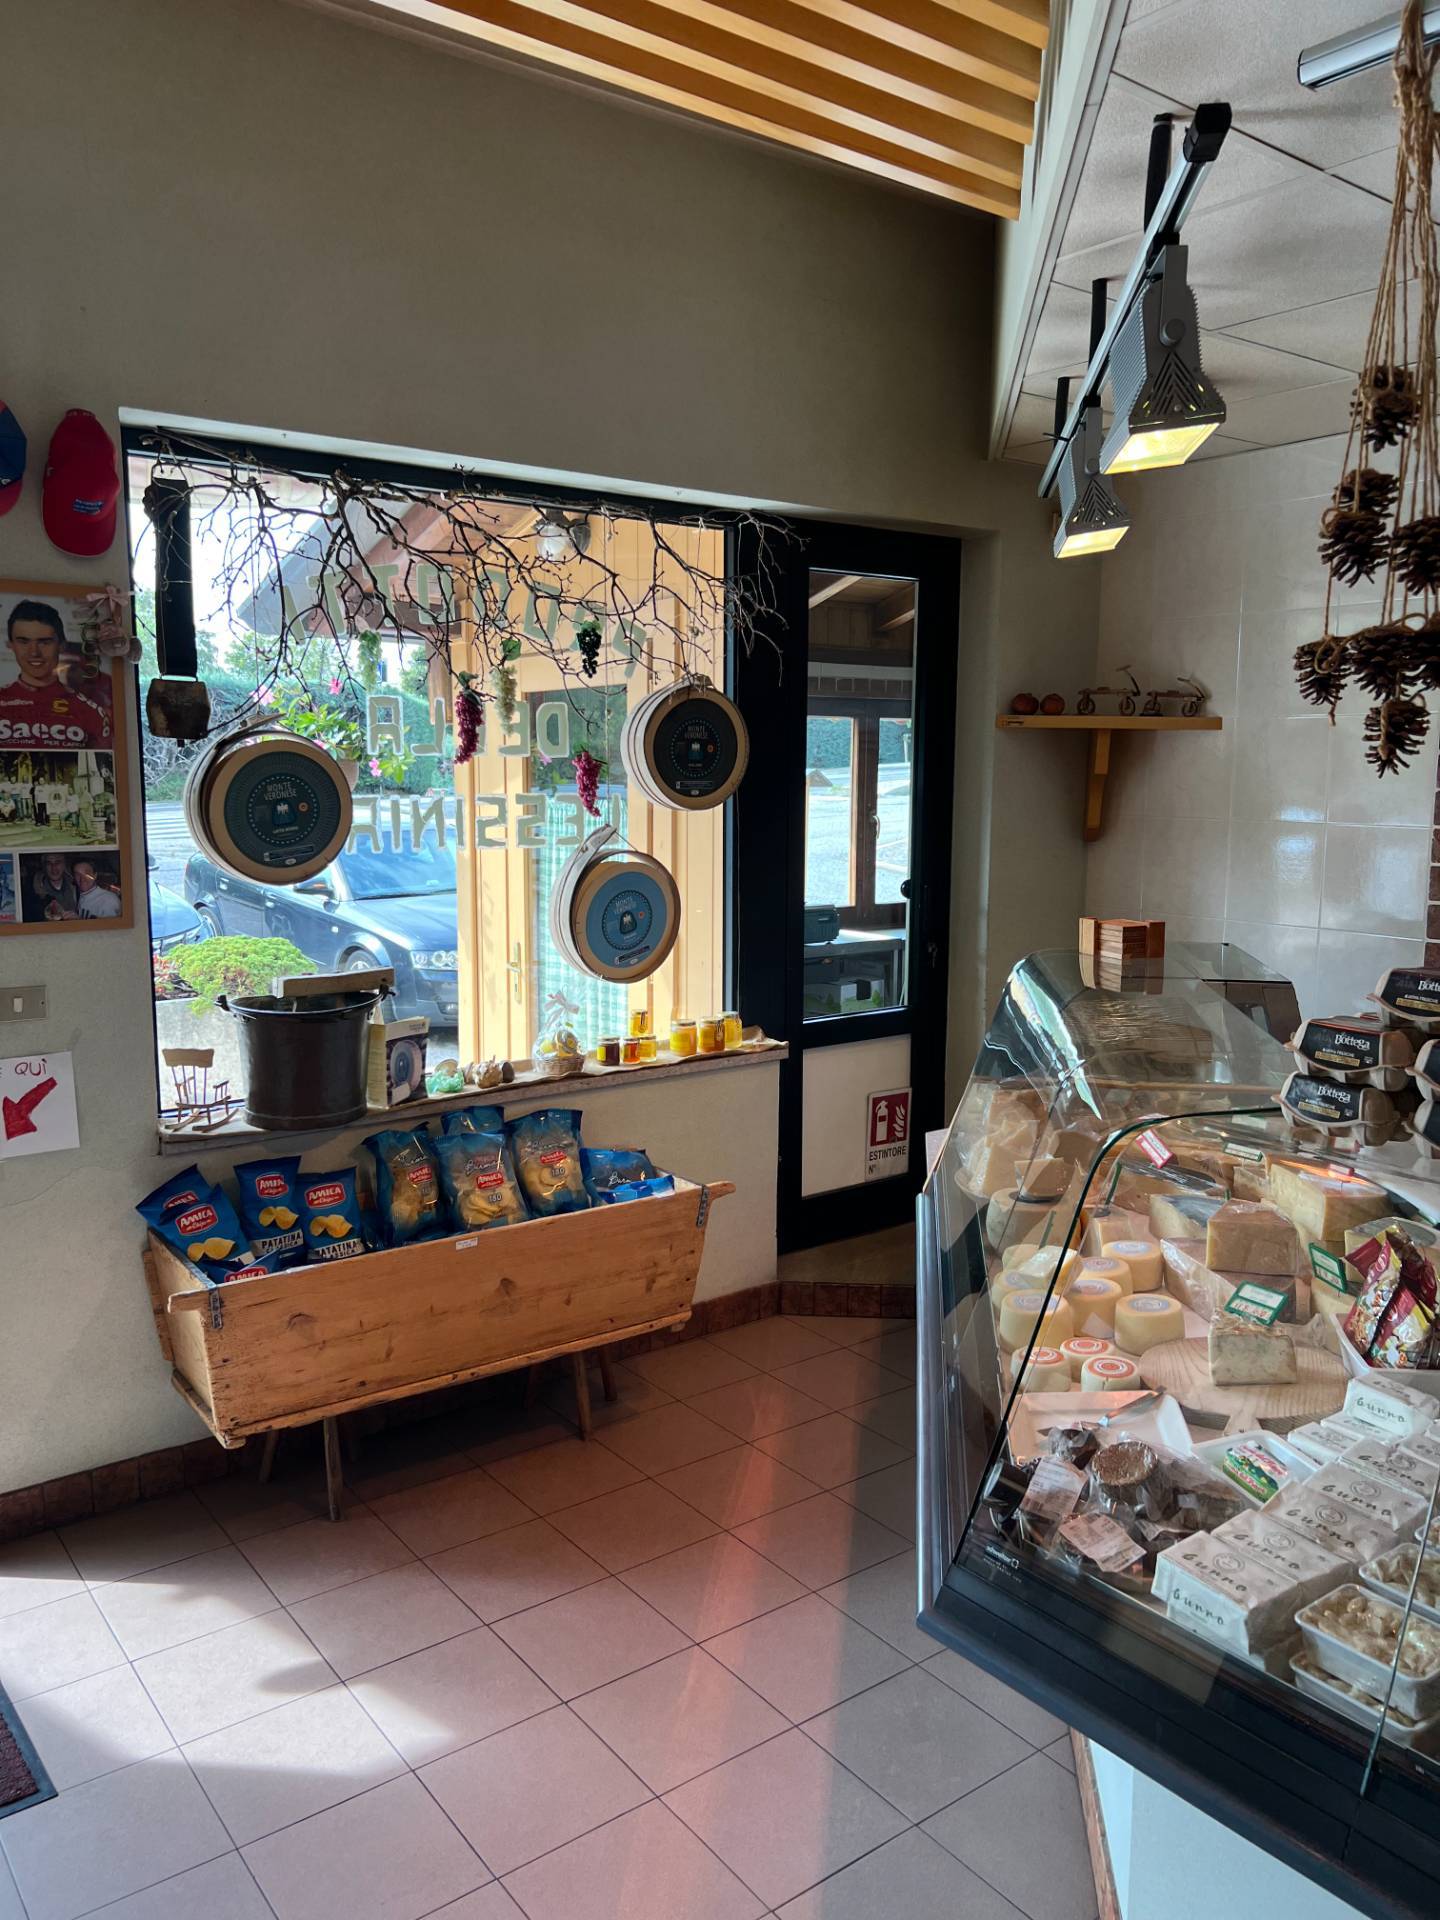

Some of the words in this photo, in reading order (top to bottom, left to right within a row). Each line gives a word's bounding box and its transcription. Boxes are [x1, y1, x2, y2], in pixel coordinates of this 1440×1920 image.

[266, 782, 291, 792] MONTE
[1335, 1033, 1371, 1051] Bottega
[1317, 1085, 1351, 1104] Bottega
[869, 1145, 907, 1161] ESTINTORE
[308, 1186, 342, 1201] AMICA
[180, 1208, 214, 1226] AMICA
[262, 1231, 302, 1249] PATATINA
[317, 1240, 357, 1256] ATATINA
